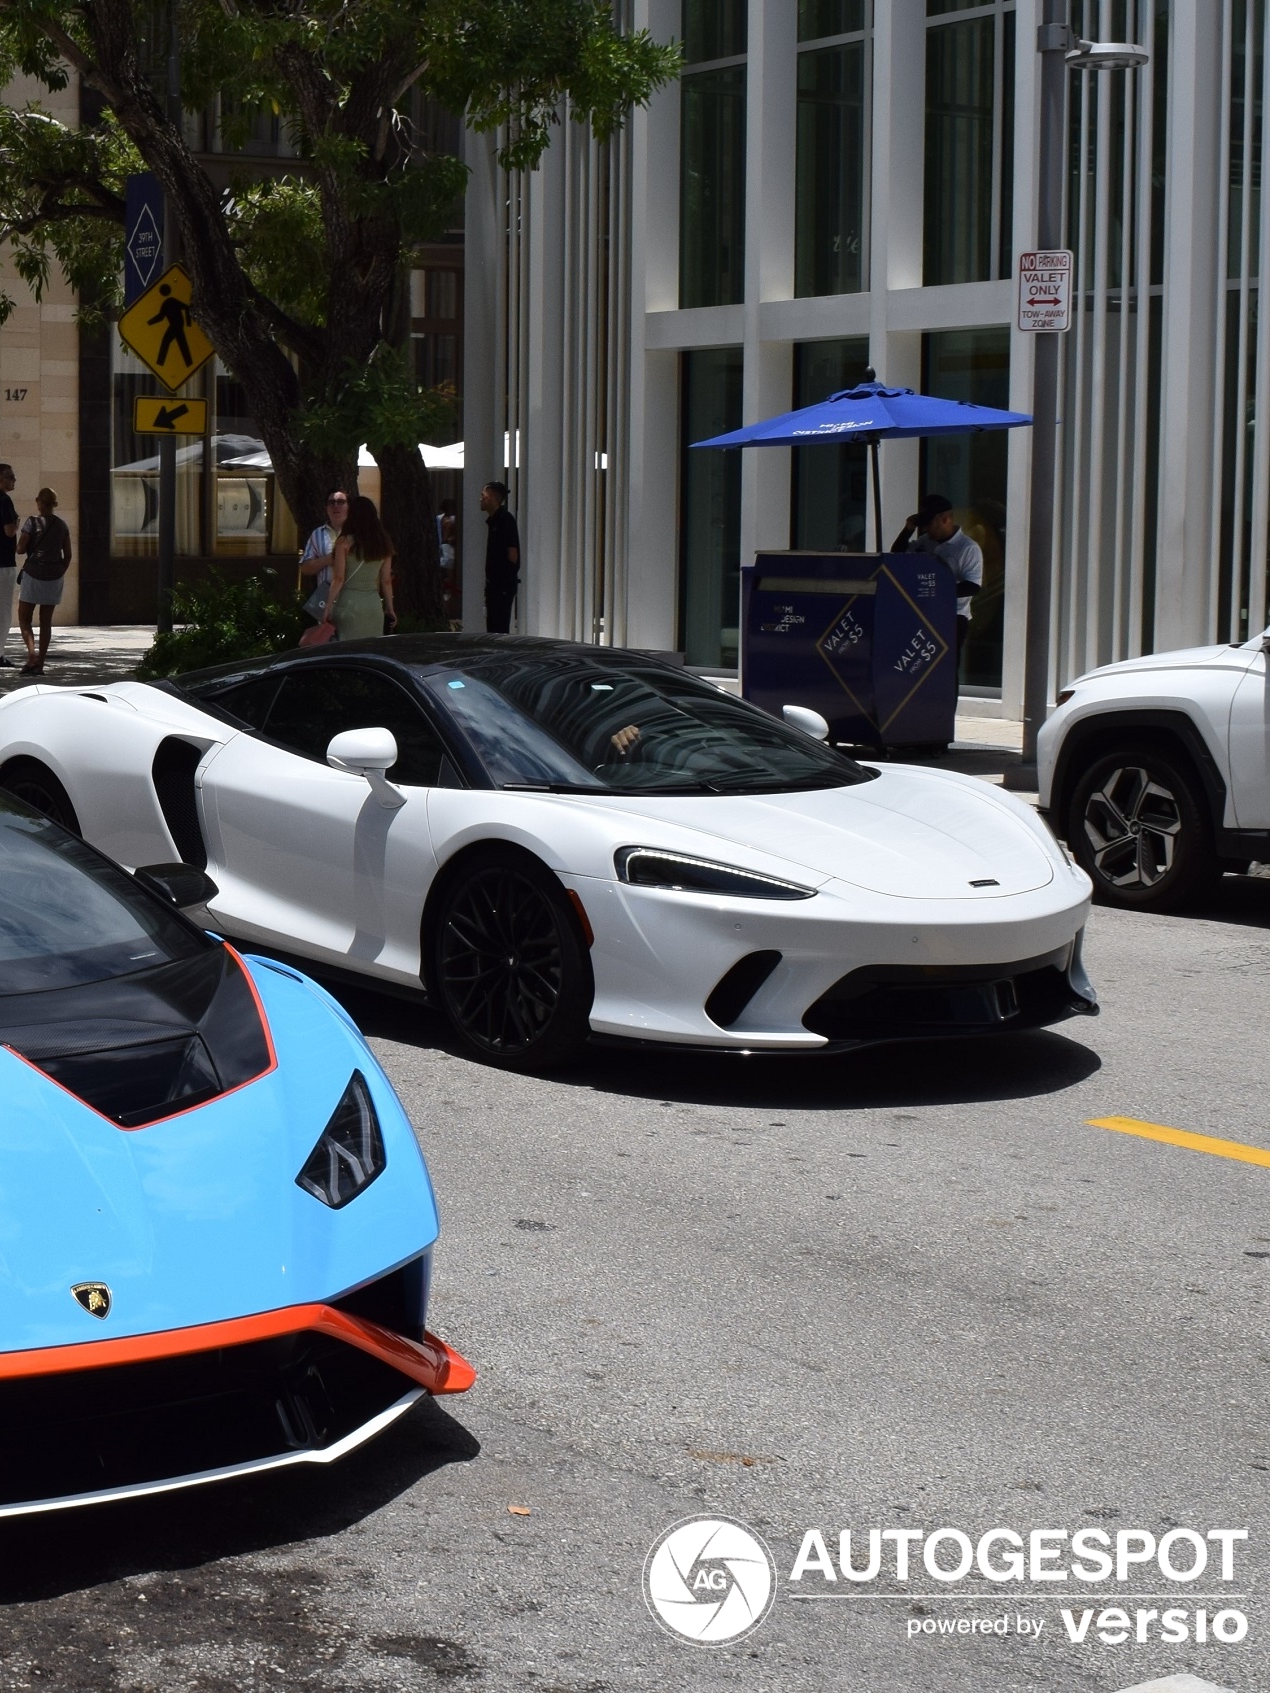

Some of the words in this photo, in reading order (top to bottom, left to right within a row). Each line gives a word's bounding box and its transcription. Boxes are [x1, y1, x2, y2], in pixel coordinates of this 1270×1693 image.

[138, 232, 153, 243] 39TH
[135, 246, 155, 258] STREET
[1021, 255, 1036, 270] NO
[1038, 255, 1067, 268] PARKING
[1023, 272, 1066, 283] VALET
[1029, 285, 1061, 296] ONLY
[1022, 310, 1066, 319] TOW-AWAY
[1031, 319, 1055, 328] ZONE
[4, 388, 28, 401] 147
[824, 610, 855, 651] VALET
[849, 623, 863, 644] $5
[893, 629, 926, 672] VALET
[920, 641, 937, 661] $5
